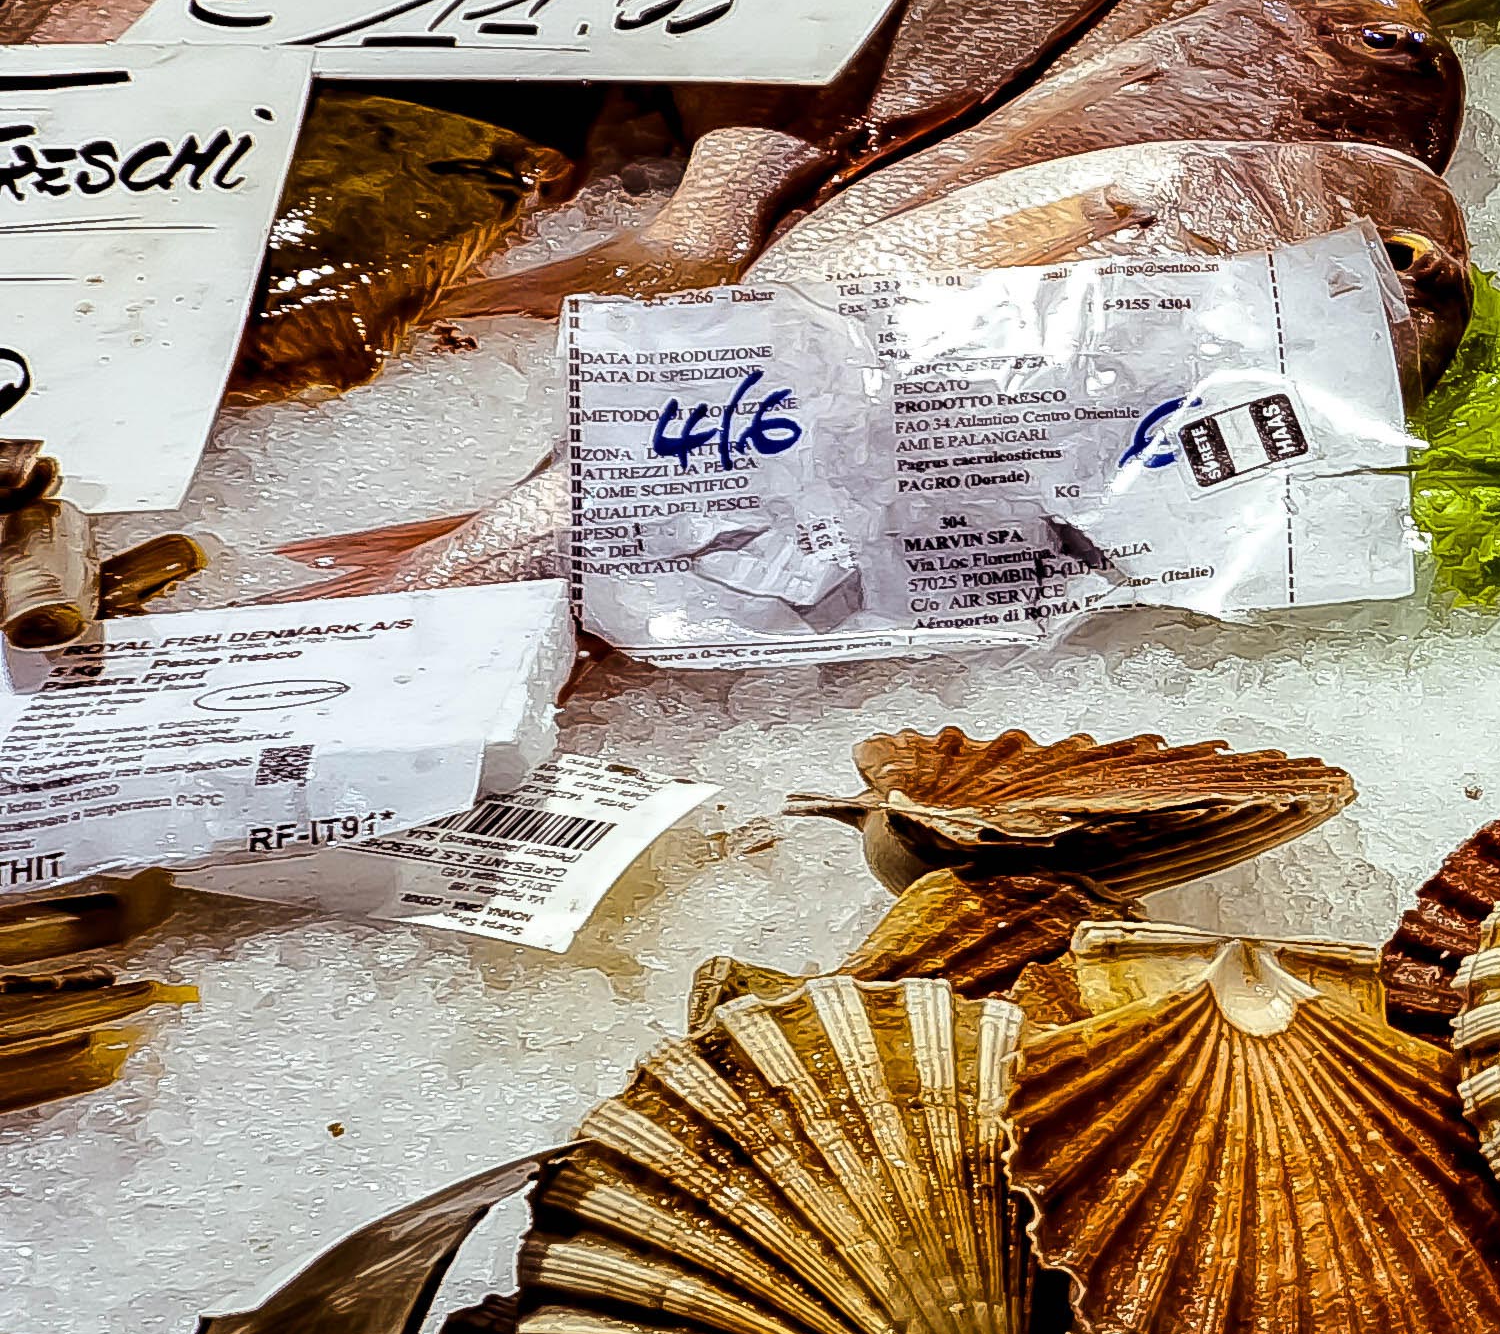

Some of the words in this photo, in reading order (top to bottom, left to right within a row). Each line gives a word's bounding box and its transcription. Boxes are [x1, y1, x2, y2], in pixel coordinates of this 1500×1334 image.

[730, 289, 775, 303] Dakar
[581, 352, 633, 365] DATA
[636, 352, 656, 365] DI
[658, 345, 773, 364] PRODUZIONE
[581, 370, 633, 383] DATA
[637, 369, 656, 383] DI
[894, 379, 970, 395] PESCATO
[894, 395, 994, 414] PRODOTTO
[997, 390, 1067, 406] FRESCO
[581, 409, 659, 423] METODO
[895, 420, 929, 435] FAO
[933, 417, 951, 431] 34
[955, 414, 1020, 429] Atlantico
[1023, 409, 1071, 425] Centro
[1074, 405, 1140, 421] Orientale
[1262, 402, 1296, 455] HAAS
[896, 437, 931, 453] AMI
[933, 436, 945, 450] E
[949, 429, 1049, 449] PALANGARI
[581, 448, 633, 462] ZONA
[897, 458, 948, 473] Pagrus
[953, 449, 1062, 467] caeruleostictus
[583, 465, 669, 481] ATTREZZI
[673, 463, 700, 477] DA
[898, 476, 961, 493] PAGRO
[965, 469, 1031, 489] (Dorade)
[583, 484, 637, 500] NOME
[640, 475, 748, 497] SCIENTIFICO
[1054, 485, 1081, 500] KG
[583, 505, 665, 521] QUALITA
[706, 495, 760, 512] PESCE
[583, 525, 628, 541] PESO
[904, 533, 984, 553] MARVIN
[988, 529, 1024, 547] SPA
[583, 559, 690, 576] IMPORTATO
[940, 556, 968, 571] Loc
[908, 575, 957, 592] 57025
[1003, 609, 1019, 622] di
[1024, 601, 1080, 620] ROMA
[1161, 565, 1216, 585] (Italie)
[949, 593, 983, 610] AIR
[986, 584, 1065, 605] SERVICE
[63, 640, 155, 657] ROYAL
[160, 632, 221, 650] FISH
[227, 622, 364, 643] DENMARK
[367, 618, 415, 632] A/S
[151, 656, 221, 669] Pesce
[228, 650, 304, 664] fresco
[142, 669, 209, 685] Fjord
[473, 853, 568, 877] CAPESANTE
